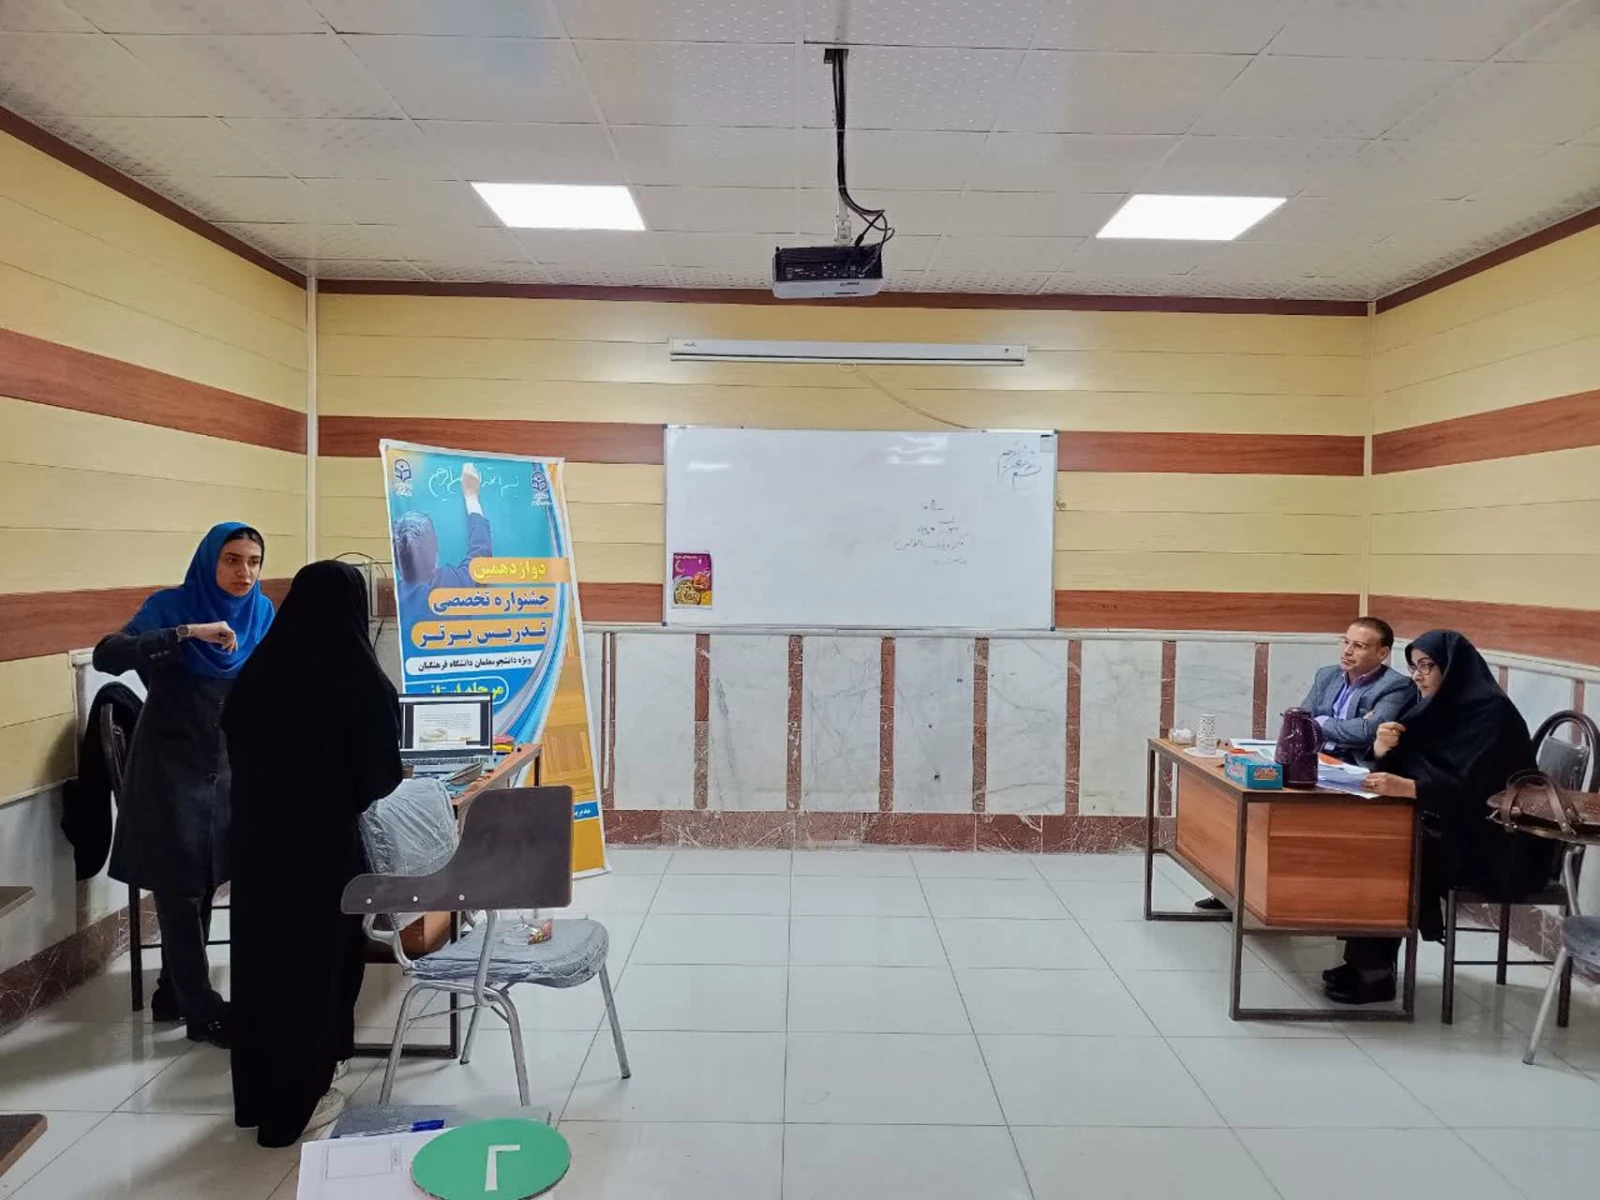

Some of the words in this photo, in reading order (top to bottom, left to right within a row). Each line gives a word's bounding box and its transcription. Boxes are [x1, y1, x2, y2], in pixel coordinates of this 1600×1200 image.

[473, 560, 547, 580] دوازدهمین
[433, 591, 491, 612] تخصصی
[494, 591, 549, 612] جشنواره
[419, 625, 472, 647] برتر
[477, 621, 547, 644] تدریس
[418, 660, 448, 671] فرهنگیان
[450, 659, 473, 667] دانشگاه
[518, 656, 532, 665] ویژه
